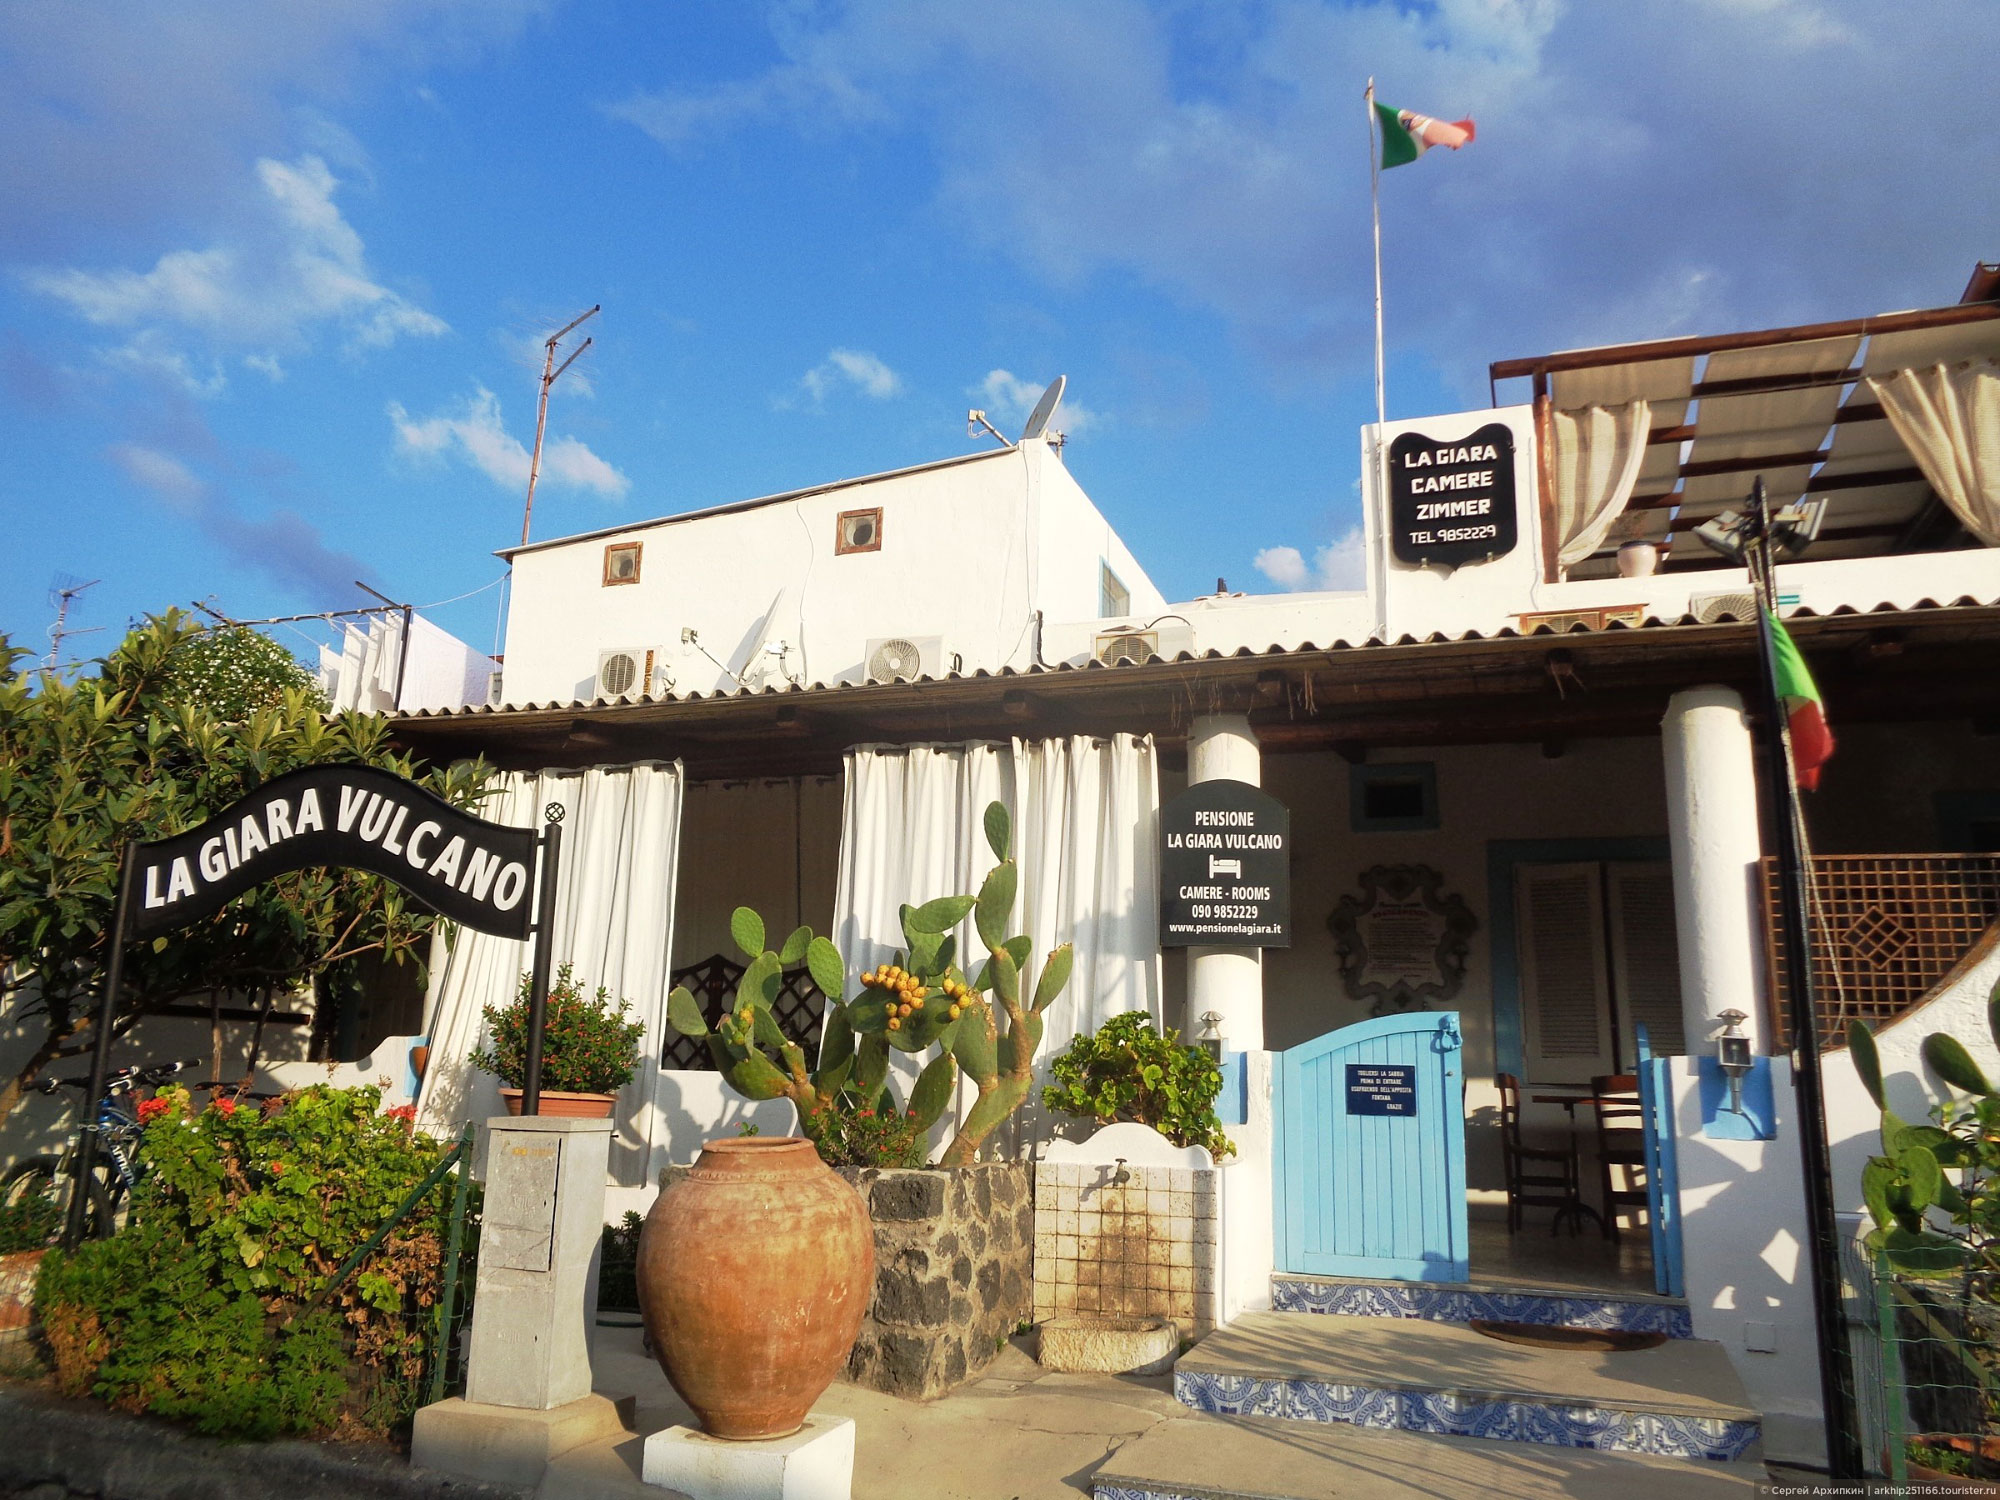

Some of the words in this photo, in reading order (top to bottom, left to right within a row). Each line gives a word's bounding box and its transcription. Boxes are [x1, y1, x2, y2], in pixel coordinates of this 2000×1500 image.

[1404, 452, 1432, 468] LA
[1436, 444, 1498, 465] GIARA
[1411, 470, 1494, 494] CAMERE
[1416, 498, 1491, 520] ZIMMER
[1409, 531, 1436, 544] TEL
[1437, 524, 1497, 542] 9852229
[1195, 811, 1254, 827] PENSIONE
[145, 857, 196, 910] LA
[199, 788, 324, 883] GIARA
[336, 784, 527, 911] VULCANO
[1167, 833, 1183, 848] LA
[1185, 833, 1223, 849] GIARA
[1225, 834, 1282, 850] VULCANO
[1179, 885, 1223, 900] CAMERE
[1231, 886, 1271, 901] ROOMS
[1192, 904, 1211, 918] 090
[1213, 905, 1259, 919] 9852229
[1169, 922, 1282, 936] www.pensionelagiara.it
